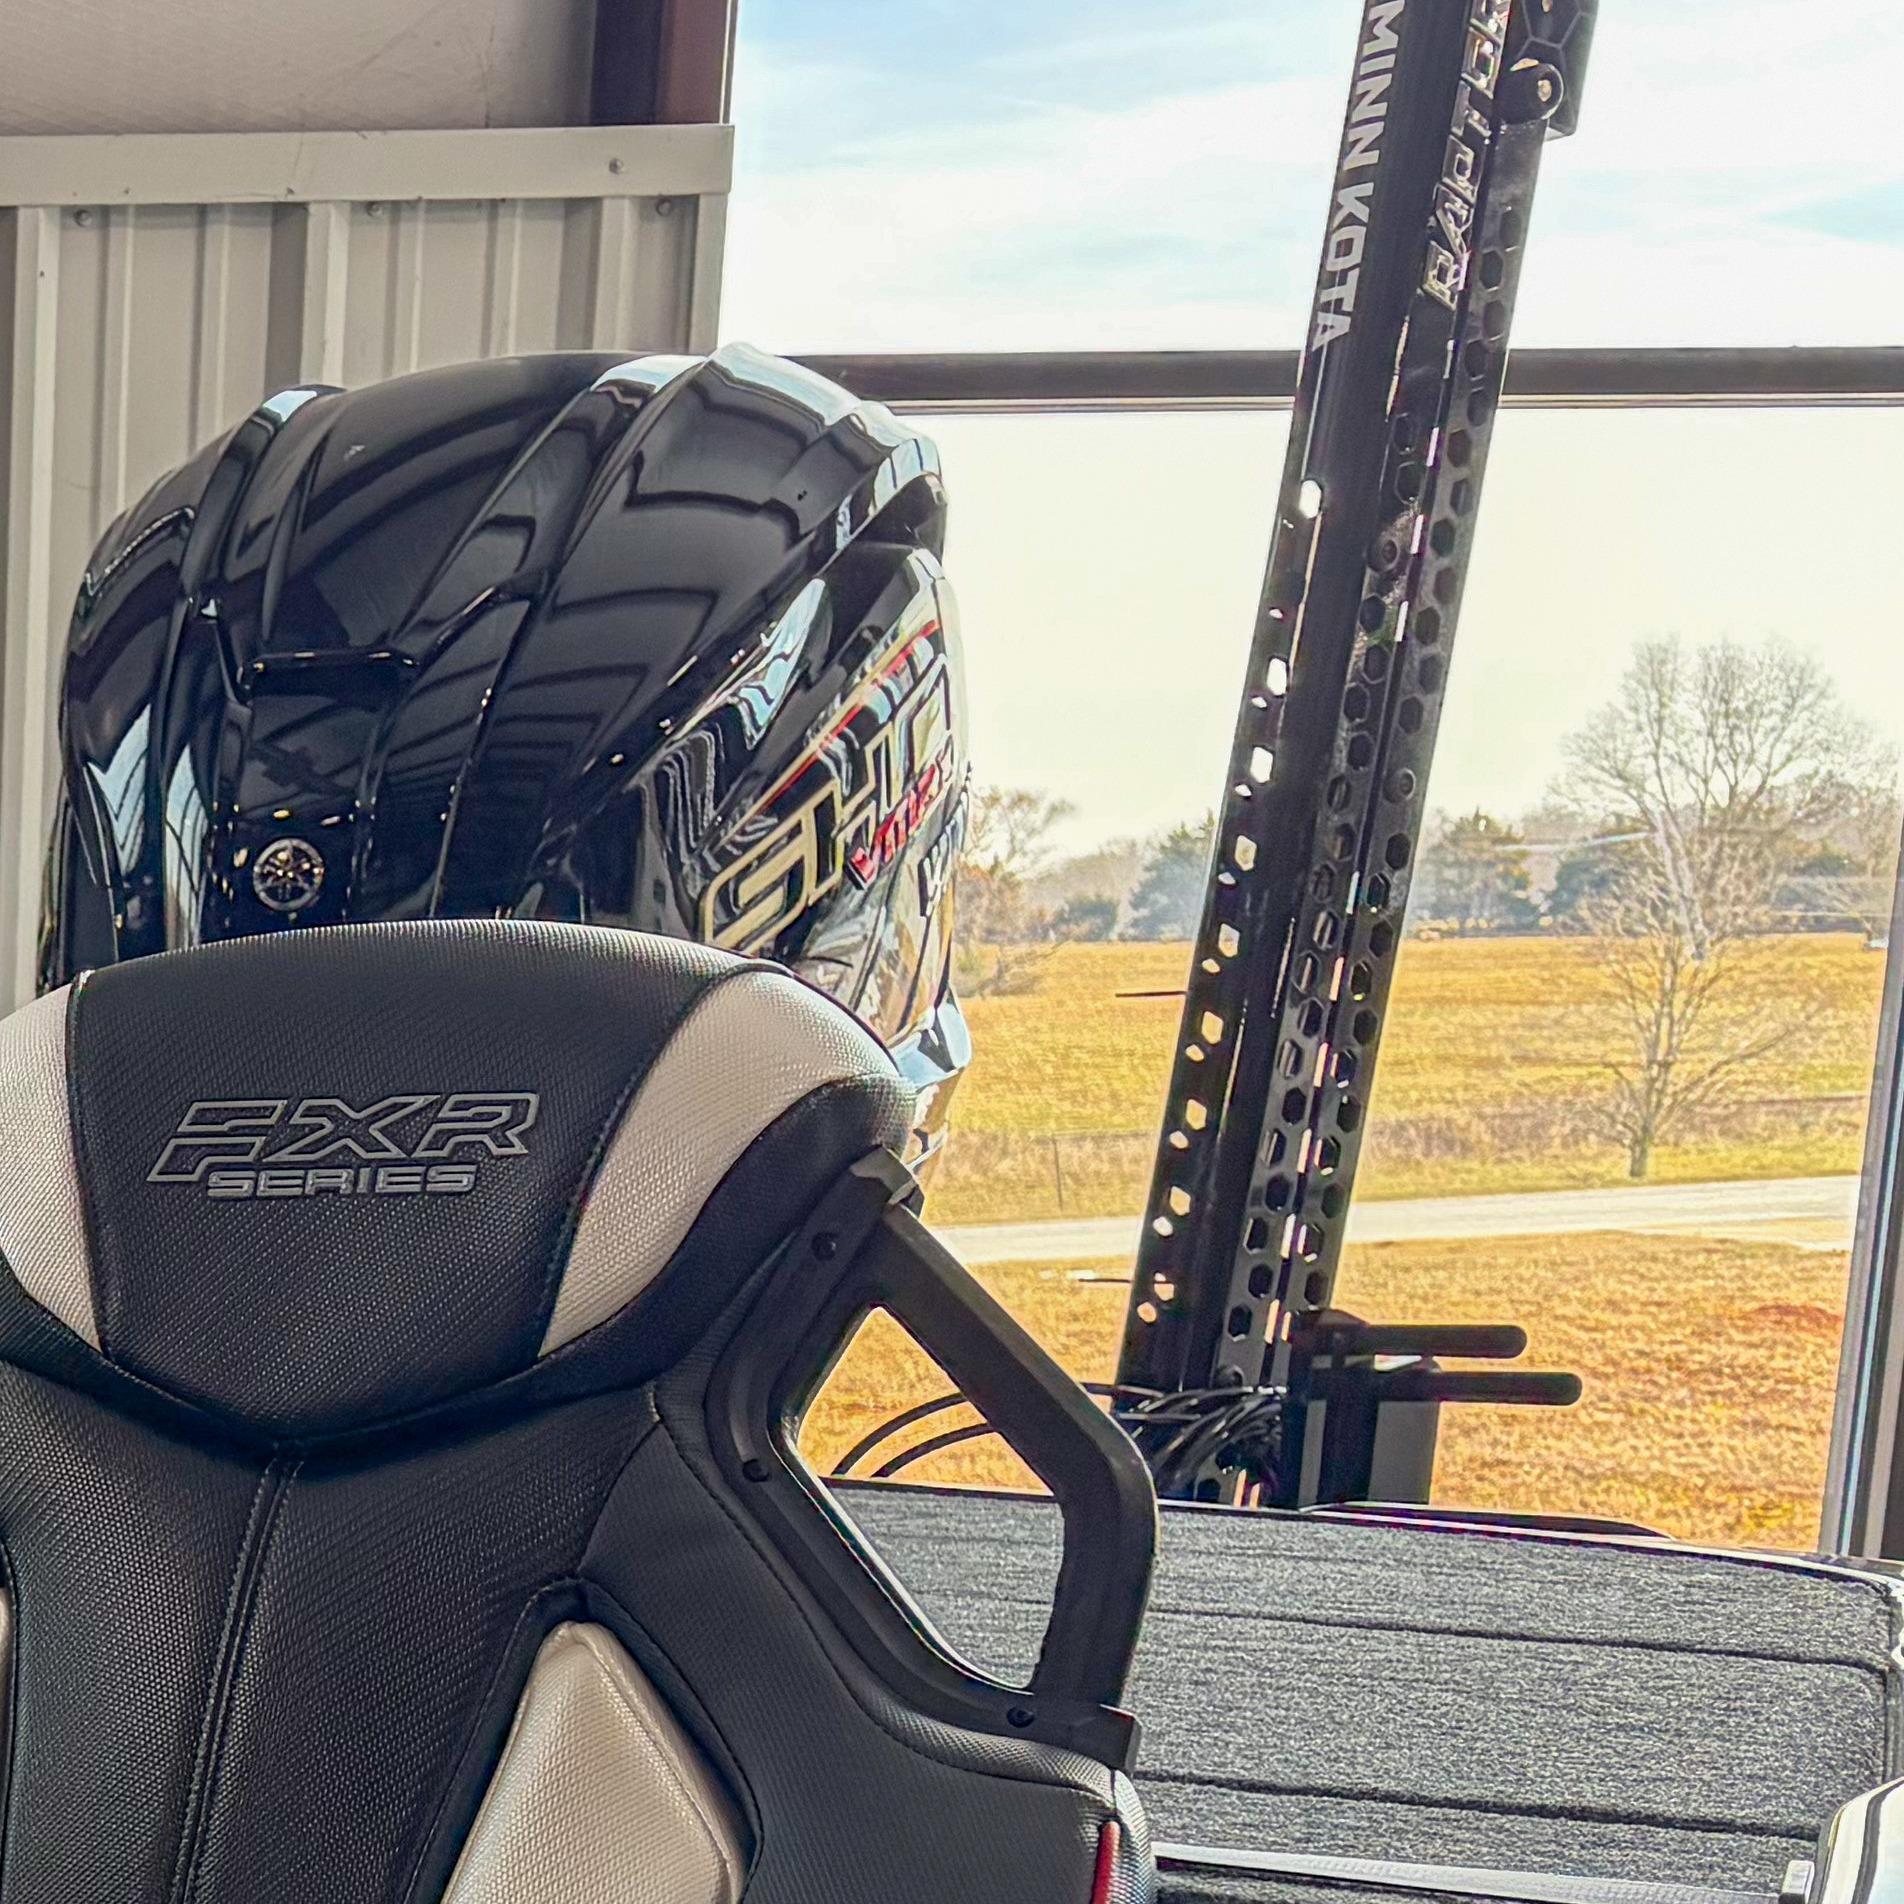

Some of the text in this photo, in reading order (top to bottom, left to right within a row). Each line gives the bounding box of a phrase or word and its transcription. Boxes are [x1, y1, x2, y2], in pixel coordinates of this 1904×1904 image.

[1312, 0, 1404, 352] MINN KOTA
[146, 1092, 540, 1182] FXR
[207, 1164, 478, 1198] SERIES
